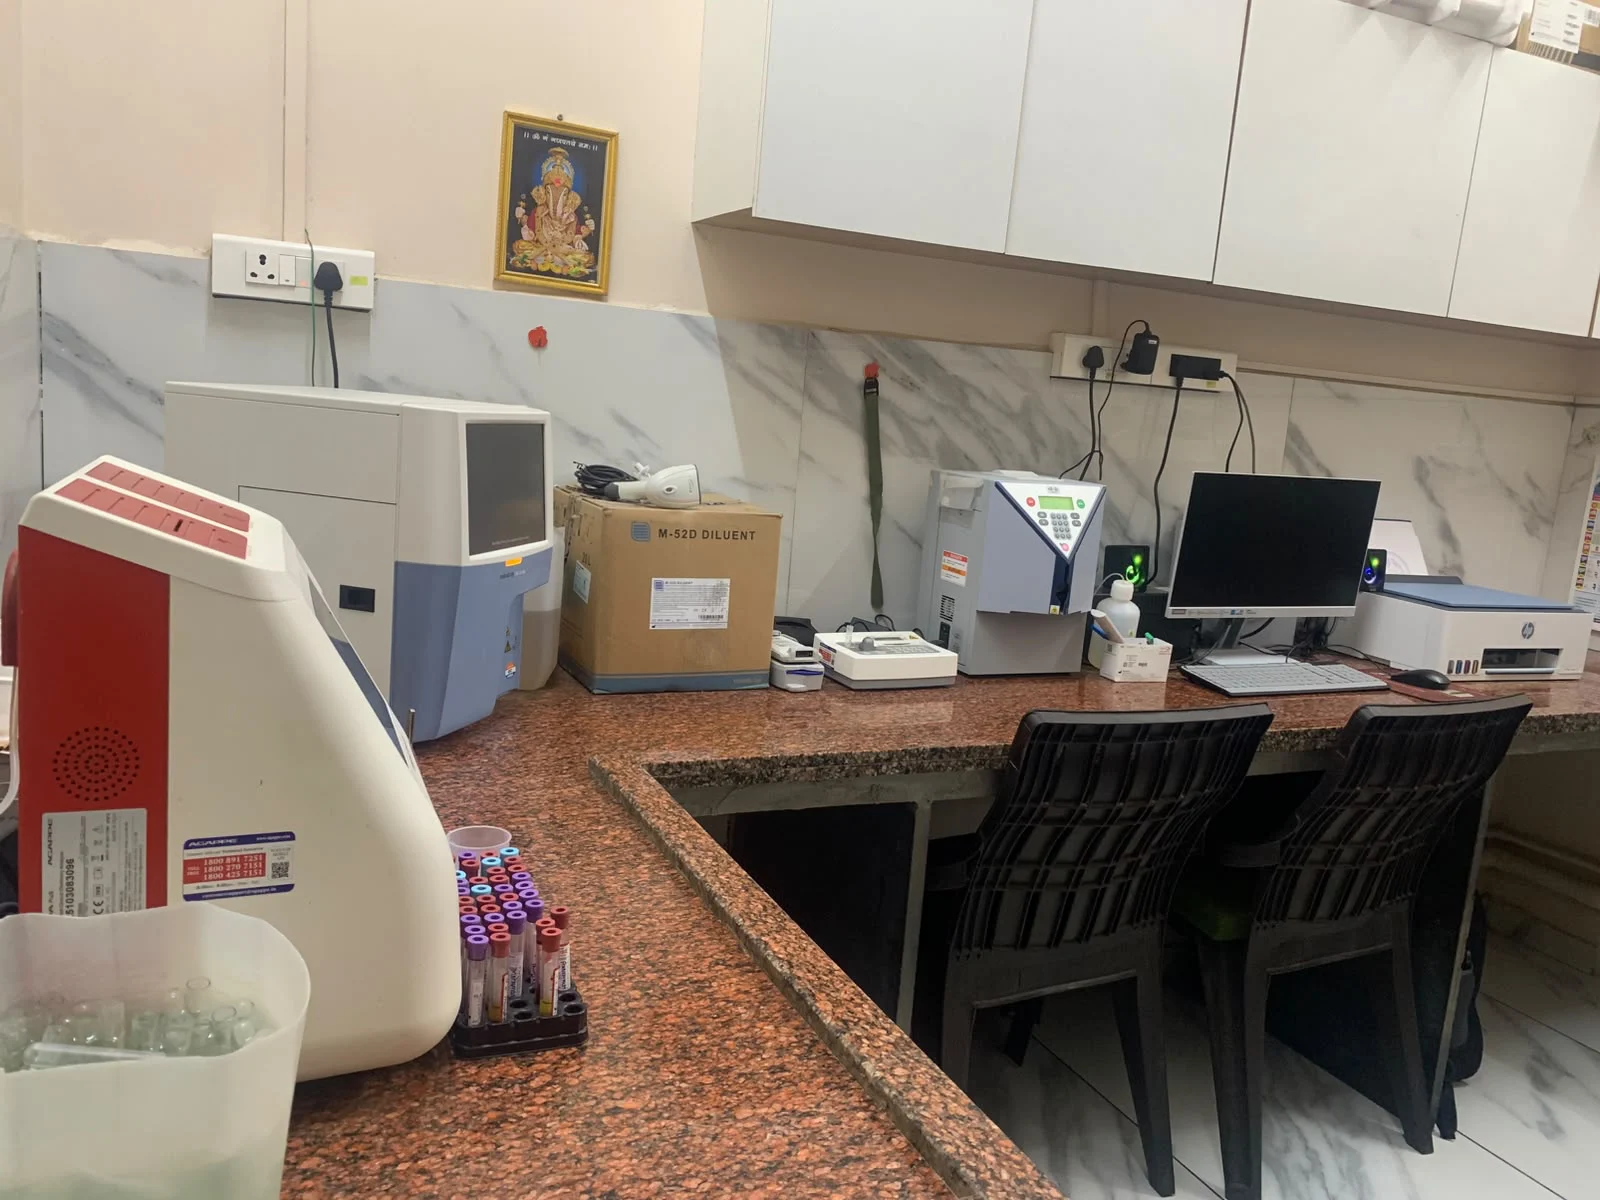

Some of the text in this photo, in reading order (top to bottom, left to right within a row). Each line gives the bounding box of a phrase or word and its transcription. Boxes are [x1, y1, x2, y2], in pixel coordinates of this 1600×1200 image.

[658, 528, 756, 541] M-52D DILUENT
[203, 854, 263, 866] 1800 891 7251
[203, 865, 223, 873] 1800
[203, 869, 263, 881] 1800 425 7151
[65, 858, 75, 917] 5103083096
